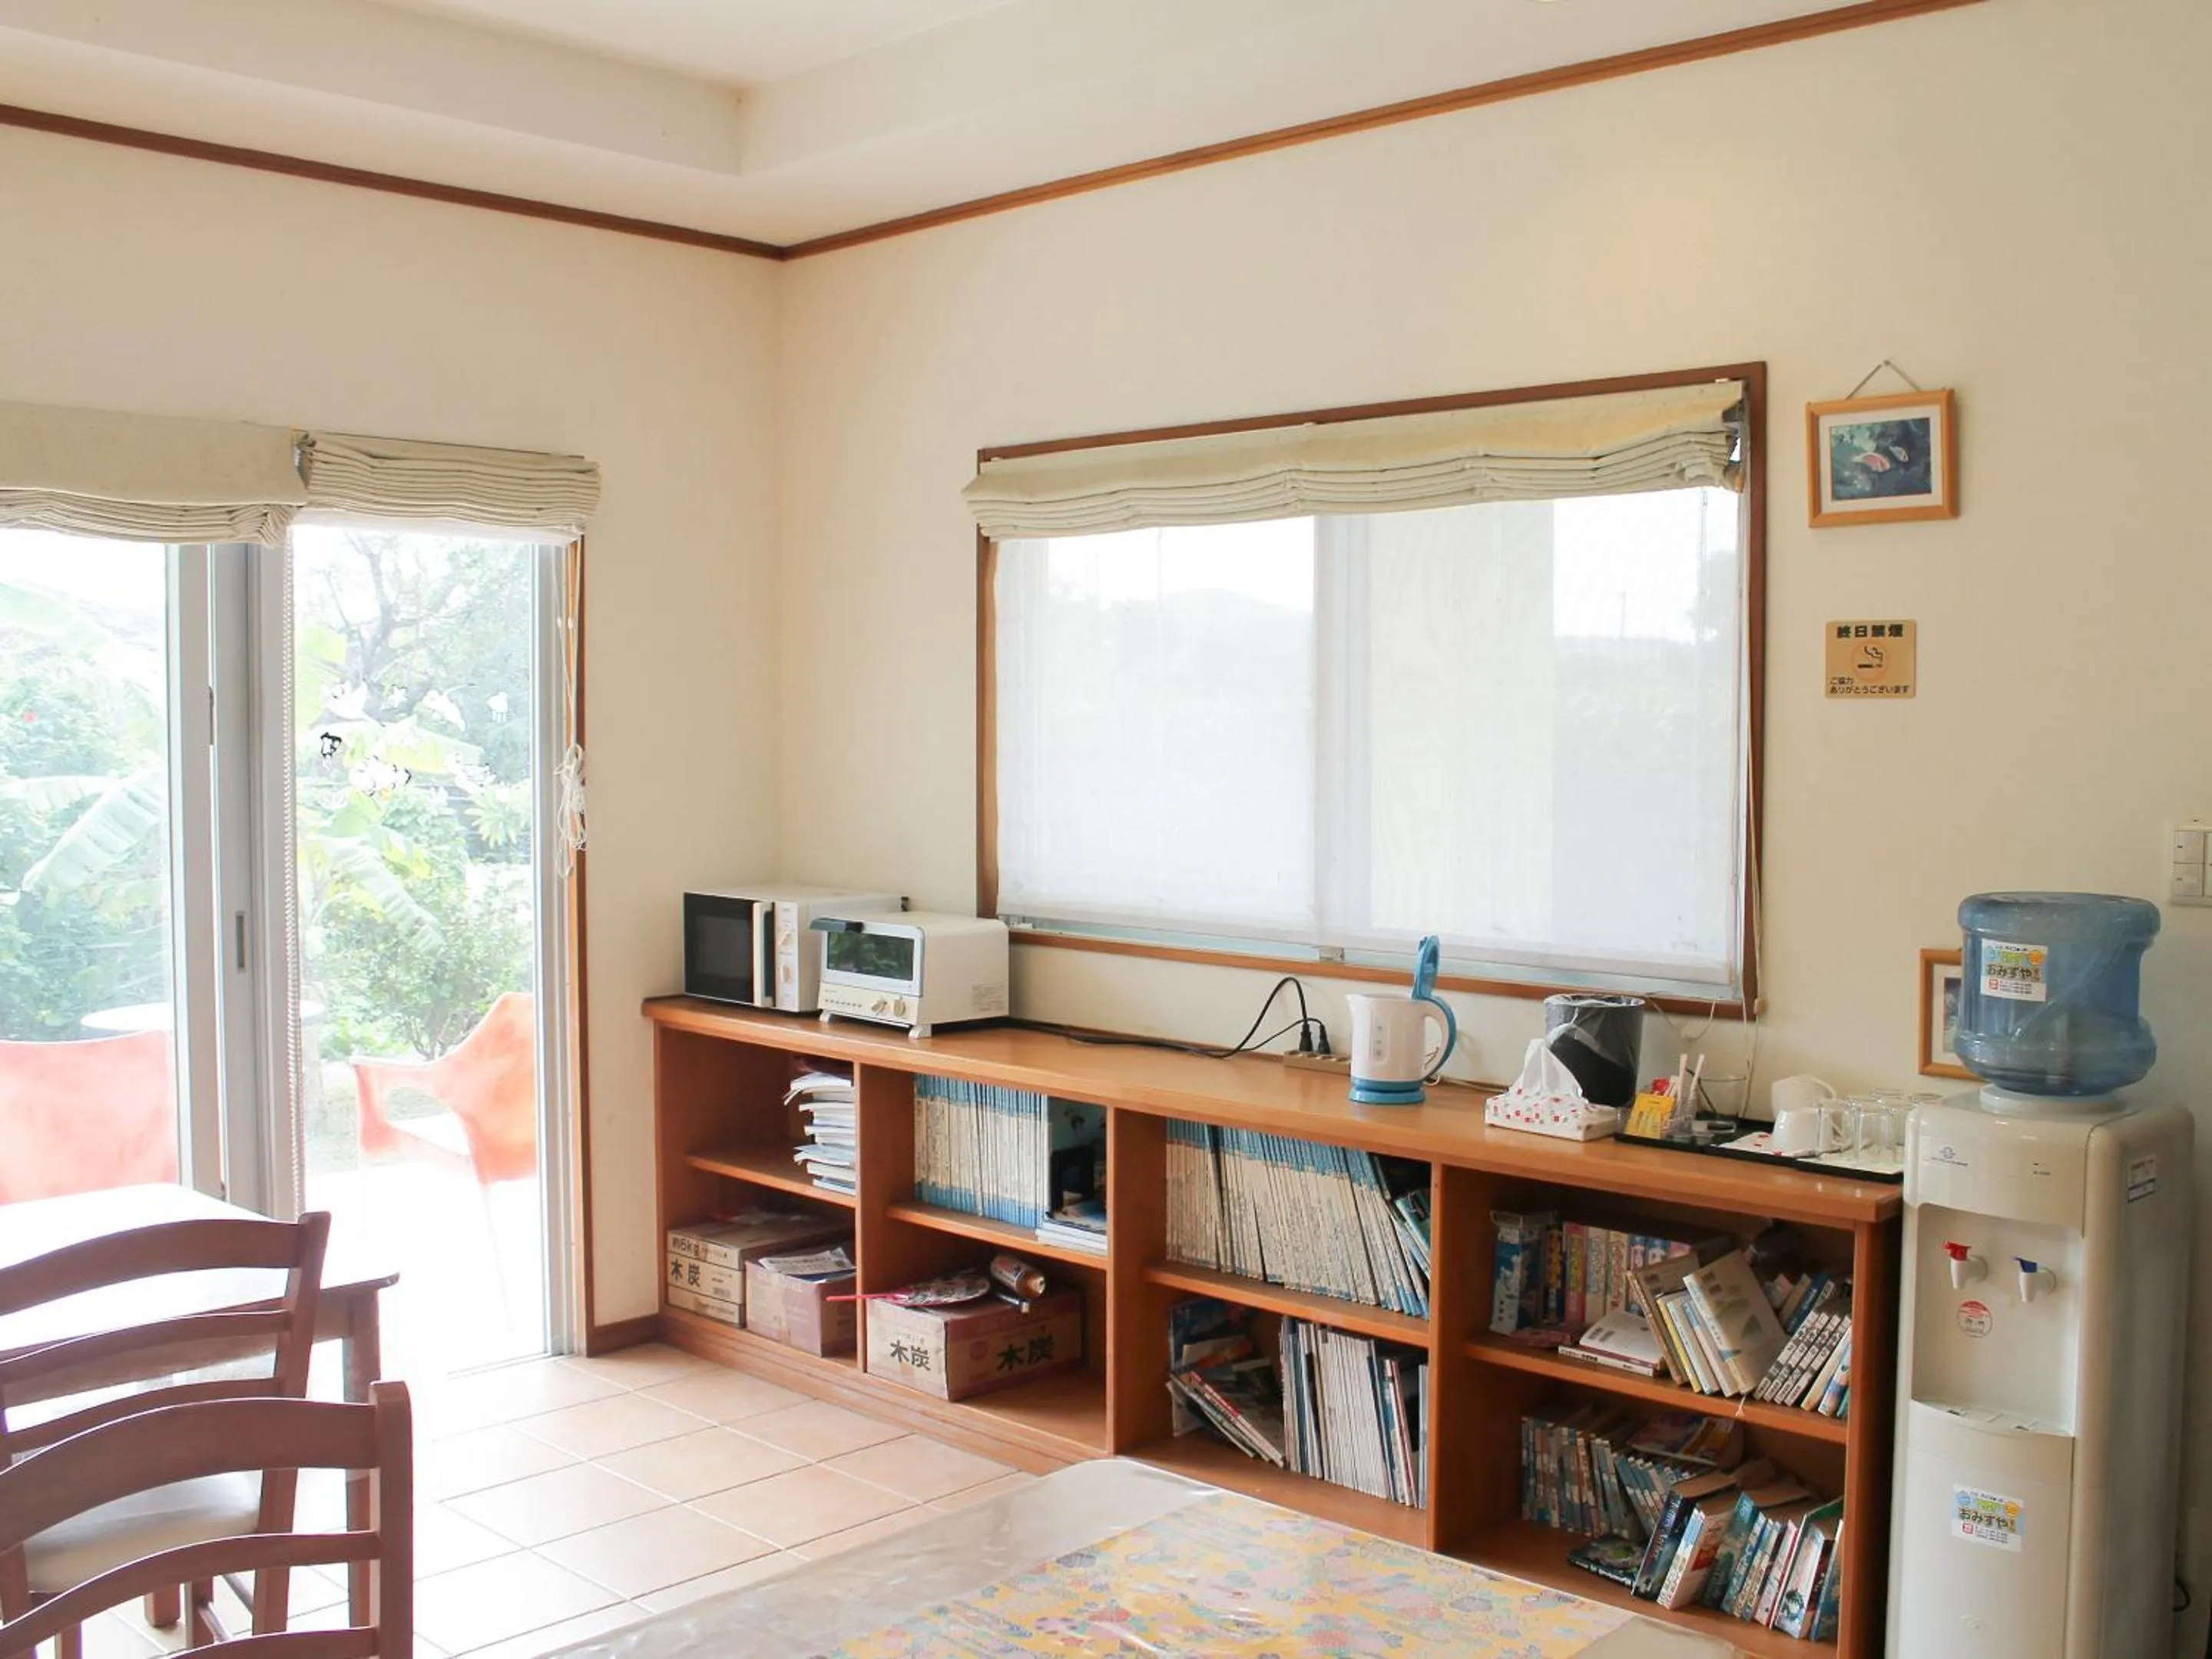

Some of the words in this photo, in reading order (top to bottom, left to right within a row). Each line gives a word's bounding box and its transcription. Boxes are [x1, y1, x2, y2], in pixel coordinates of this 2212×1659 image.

[671, 1258, 700, 1287] 木炭
[889, 1339, 931, 1371] 木炭
[997, 1333, 1055, 1371] 木炭
